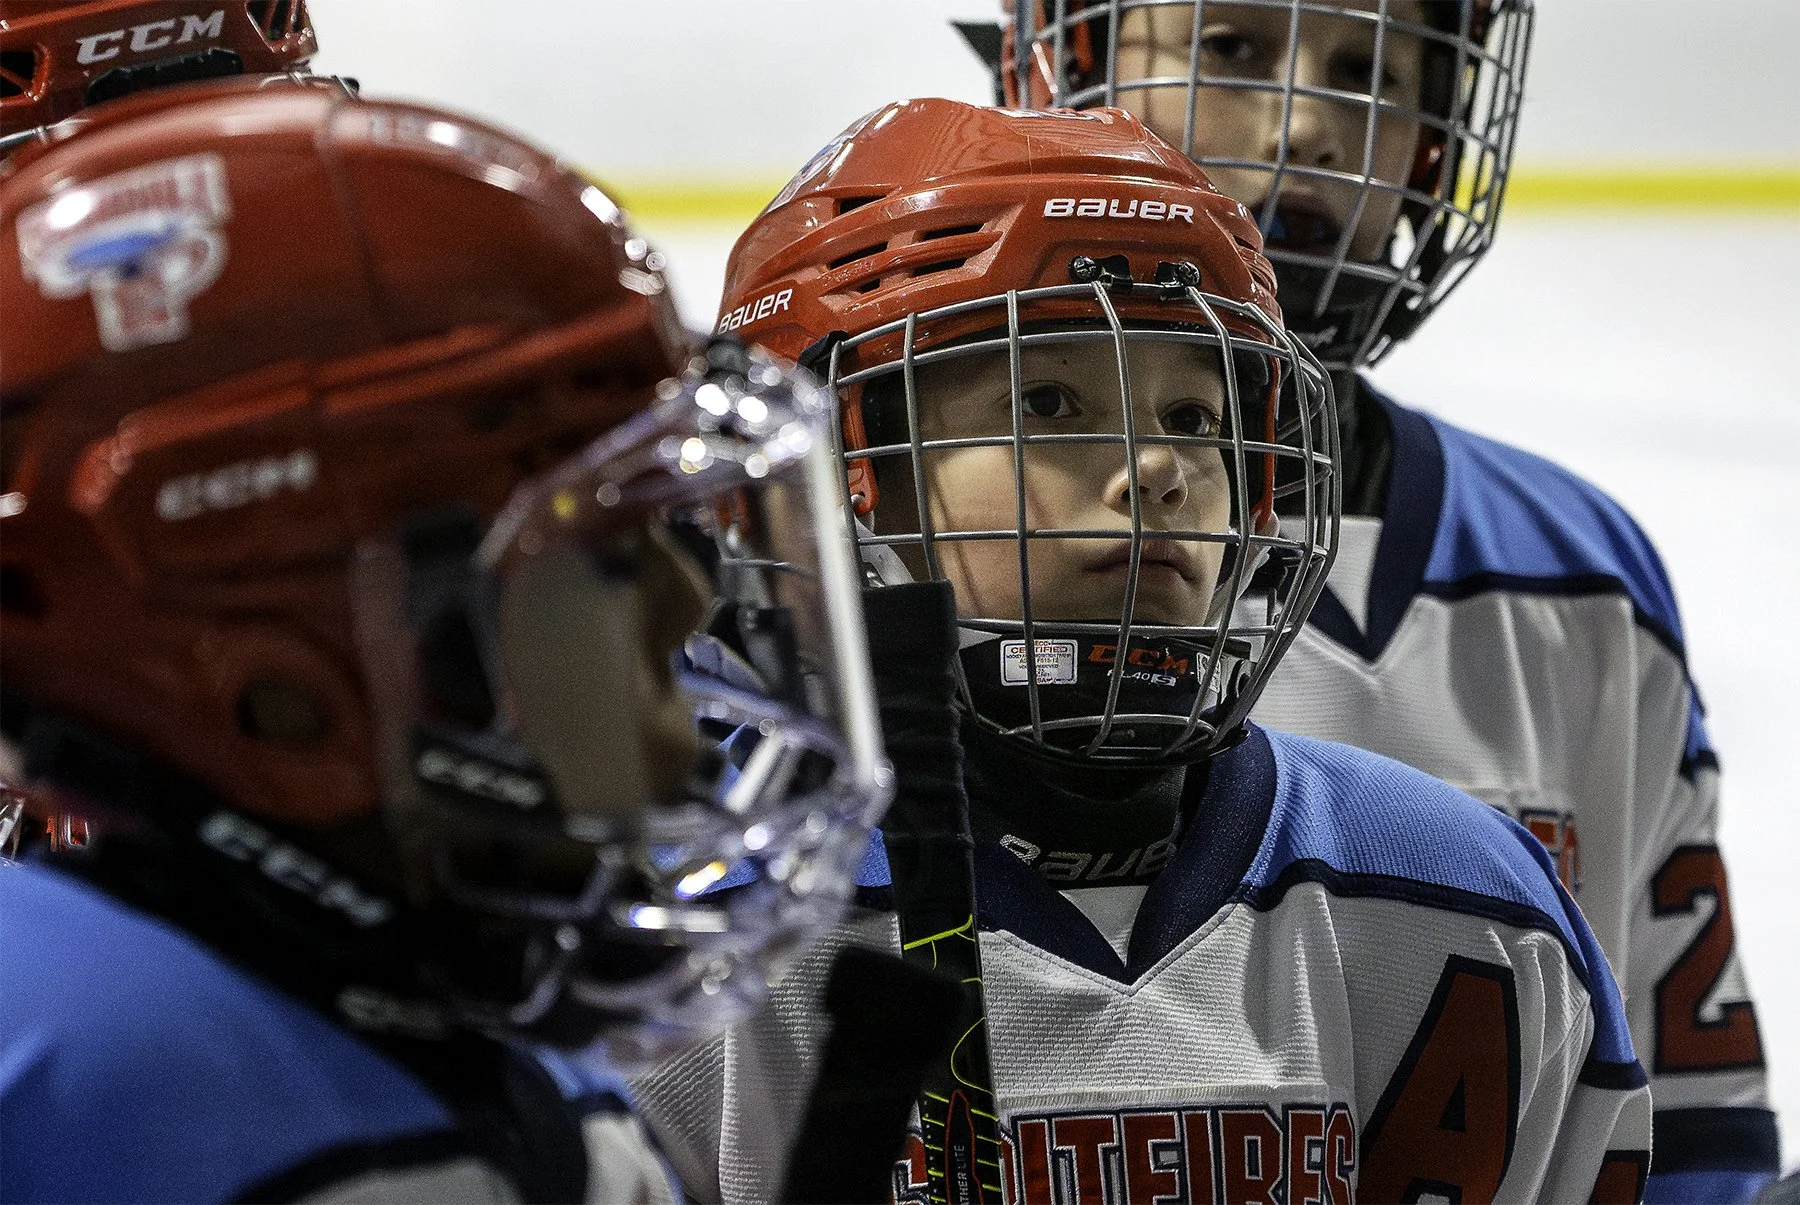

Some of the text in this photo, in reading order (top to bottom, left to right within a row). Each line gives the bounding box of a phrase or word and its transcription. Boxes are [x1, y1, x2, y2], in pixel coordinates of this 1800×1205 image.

[76, 10, 225, 65] CCM
[1043, 198, 1194, 224] BAUER
[1088, 644, 1189, 675] CCM
[1000, 834, 1178, 881] BAUE
[1652, 844, 1768, 1075] 2
[1355, 953, 1523, 1205] A
[893, 1104, 1356, 1205] ITFIRES
